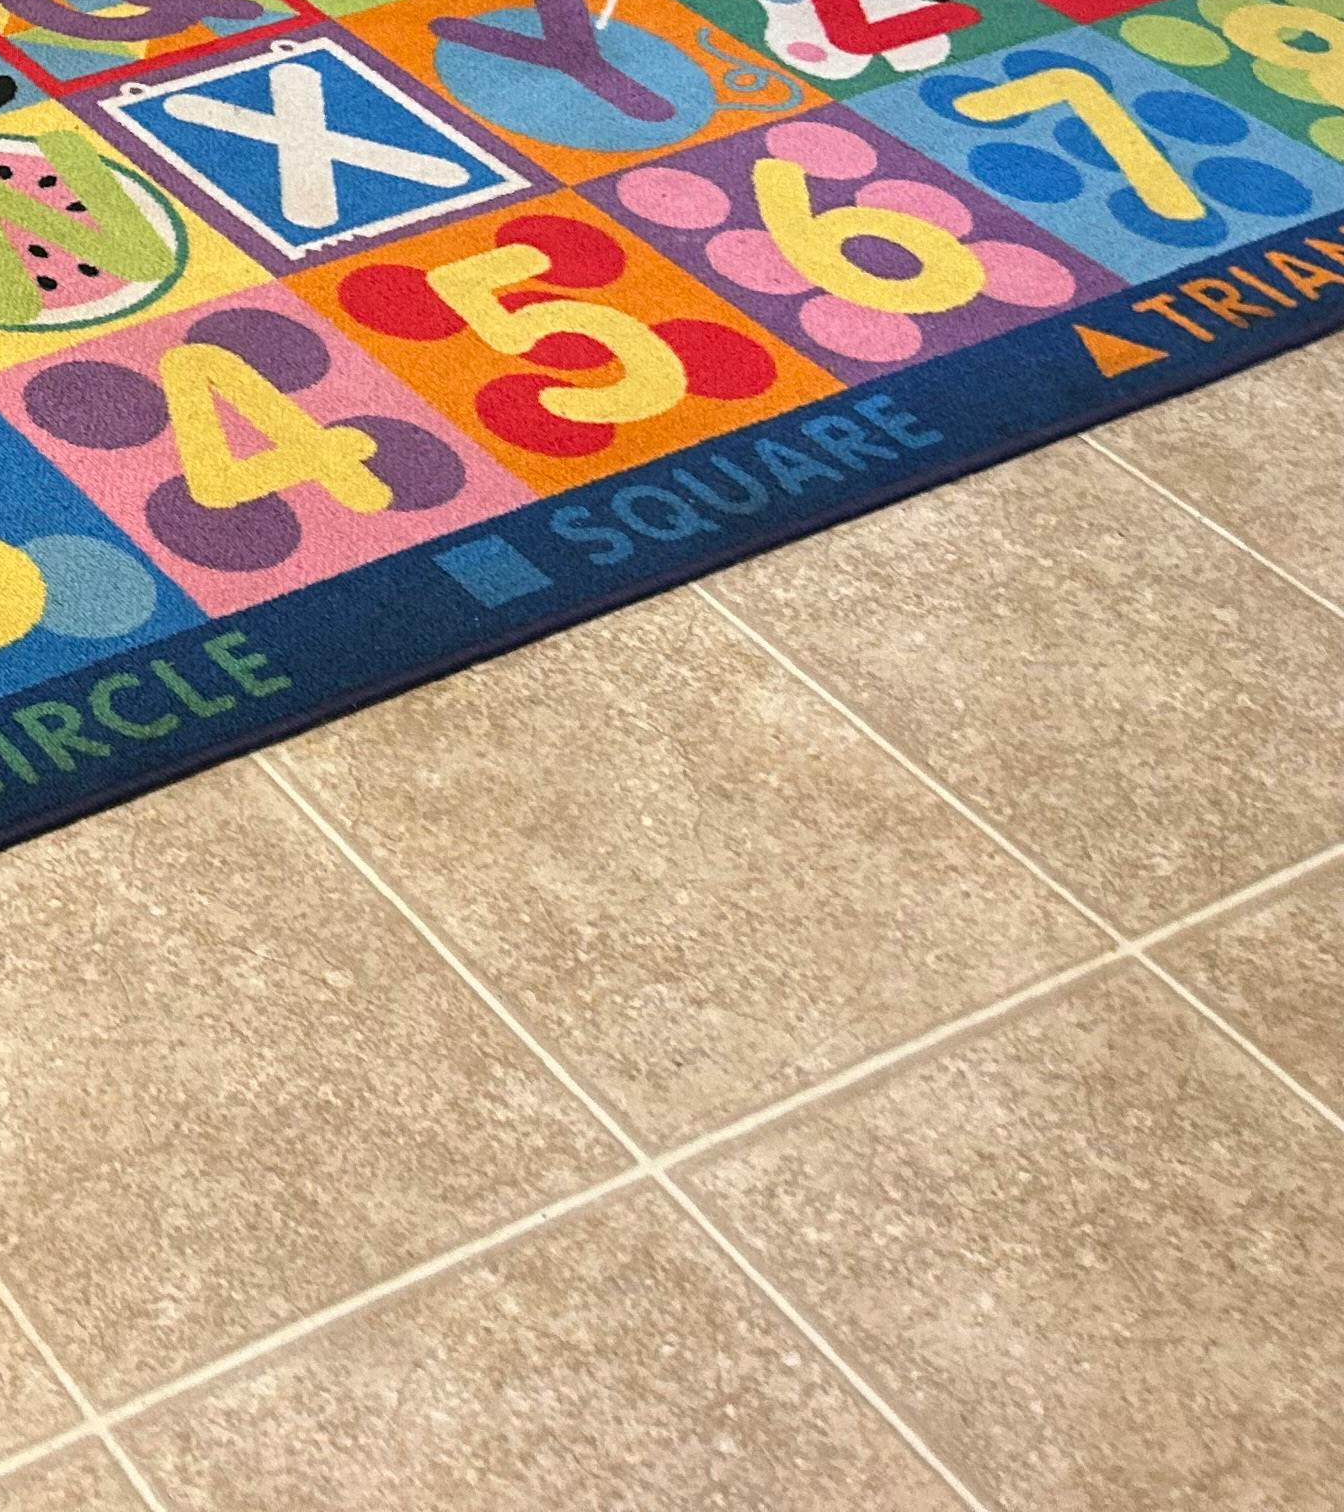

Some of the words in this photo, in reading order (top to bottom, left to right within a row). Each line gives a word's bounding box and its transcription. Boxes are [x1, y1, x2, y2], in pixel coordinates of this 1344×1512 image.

[163, 62, 470, 228] X
[160, 342, 394, 514] 4
[427, 243, 688, 424] 5
[752, 157, 988, 314] 6
[952, 67, 1208, 221] 7
[550, 392, 944, 567] SQUARE
